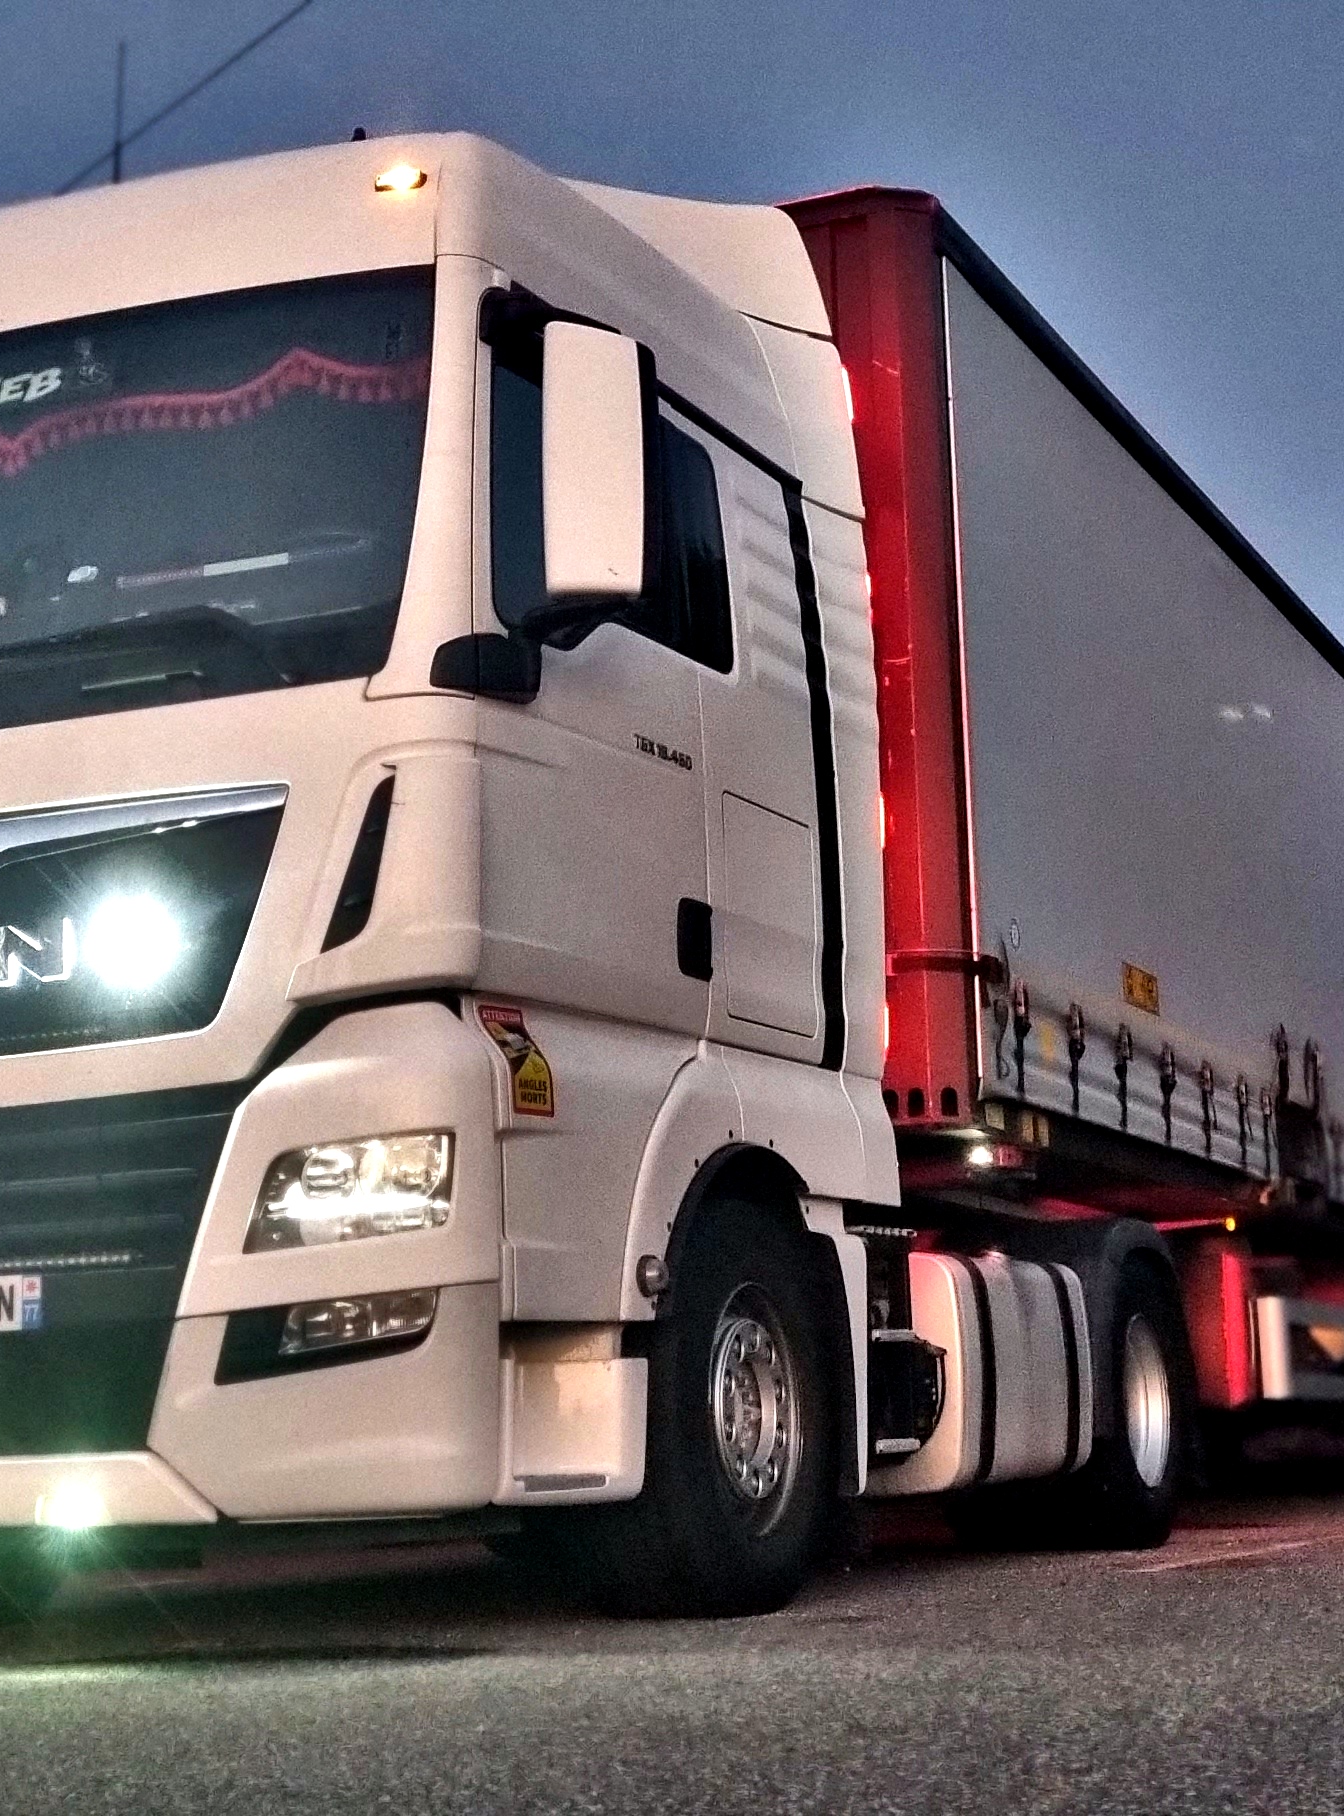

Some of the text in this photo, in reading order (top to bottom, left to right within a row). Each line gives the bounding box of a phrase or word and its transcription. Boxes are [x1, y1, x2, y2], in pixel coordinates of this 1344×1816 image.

[518, 1078, 548, 1093] ANGLES
[520, 1091, 547, 1106] MORTS
[23, 1303, 40, 1323] 77
